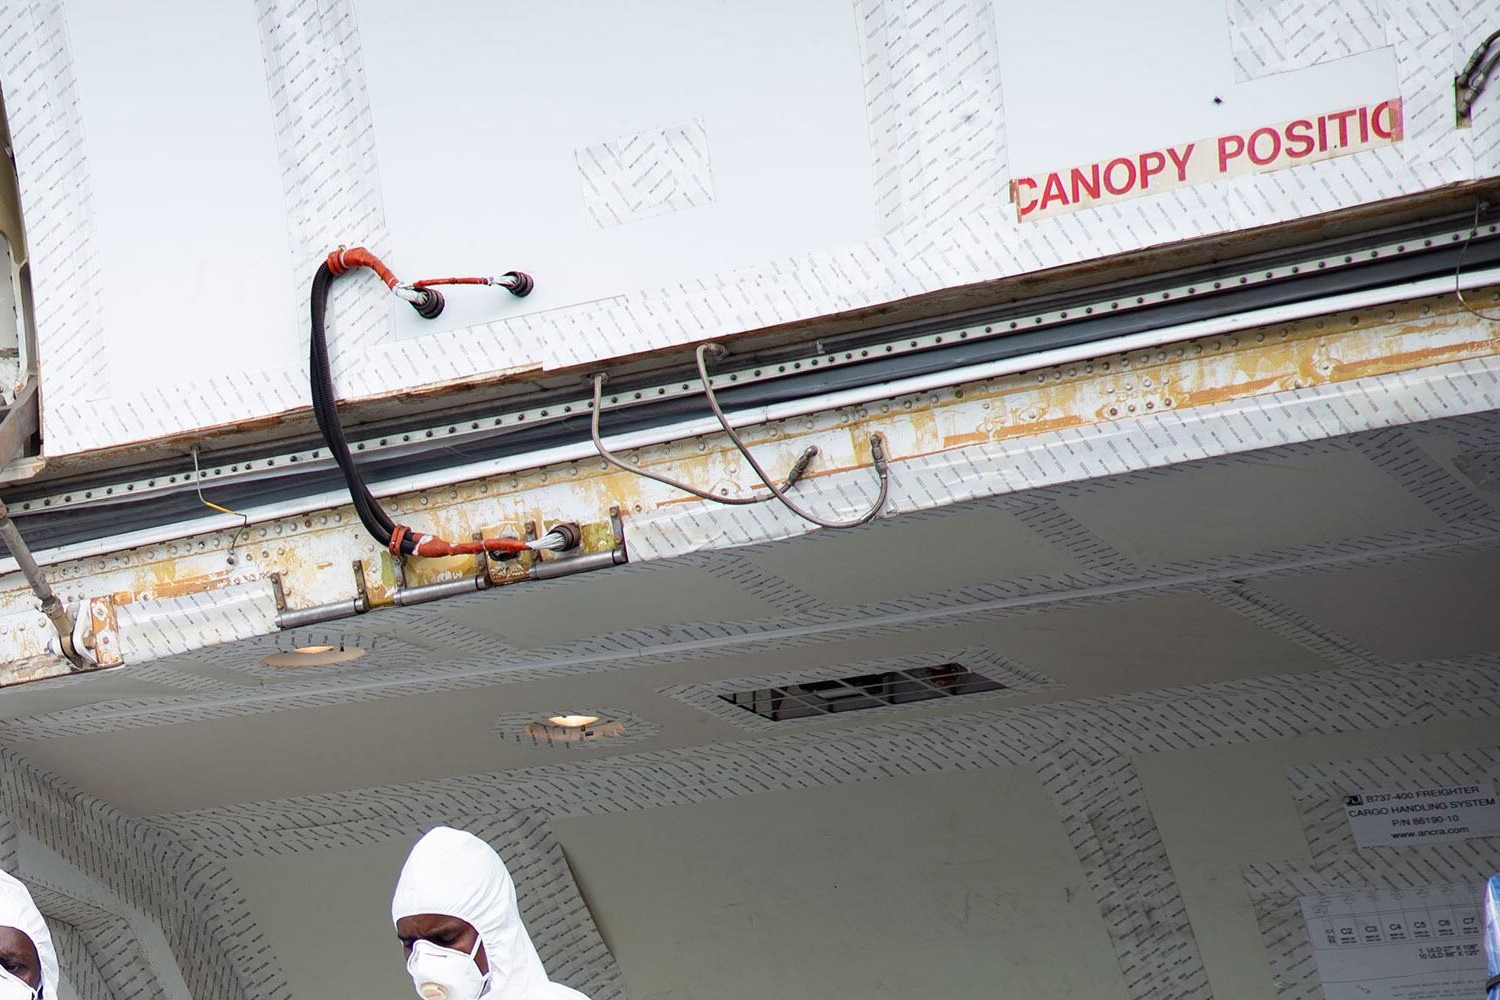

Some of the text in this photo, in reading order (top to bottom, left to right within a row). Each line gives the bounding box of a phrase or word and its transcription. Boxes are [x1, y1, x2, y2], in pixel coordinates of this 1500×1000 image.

[1017, 143, 1196, 216] CANOPY
[1366, 785, 1480, 803] B737-400 FREIGHTER
[1348, 798, 1496, 818] CARGO HANDLING SYSTEM
[1391, 818, 1411, 827] P/N
[1391, 826, 1469, 839] www.ancra.com
[1340, 927, 1354, 935] C2
[1364, 925, 1378, 933] C3
[1389, 923, 1402, 931] C4
[1462, 917, 1475, 925] C7
